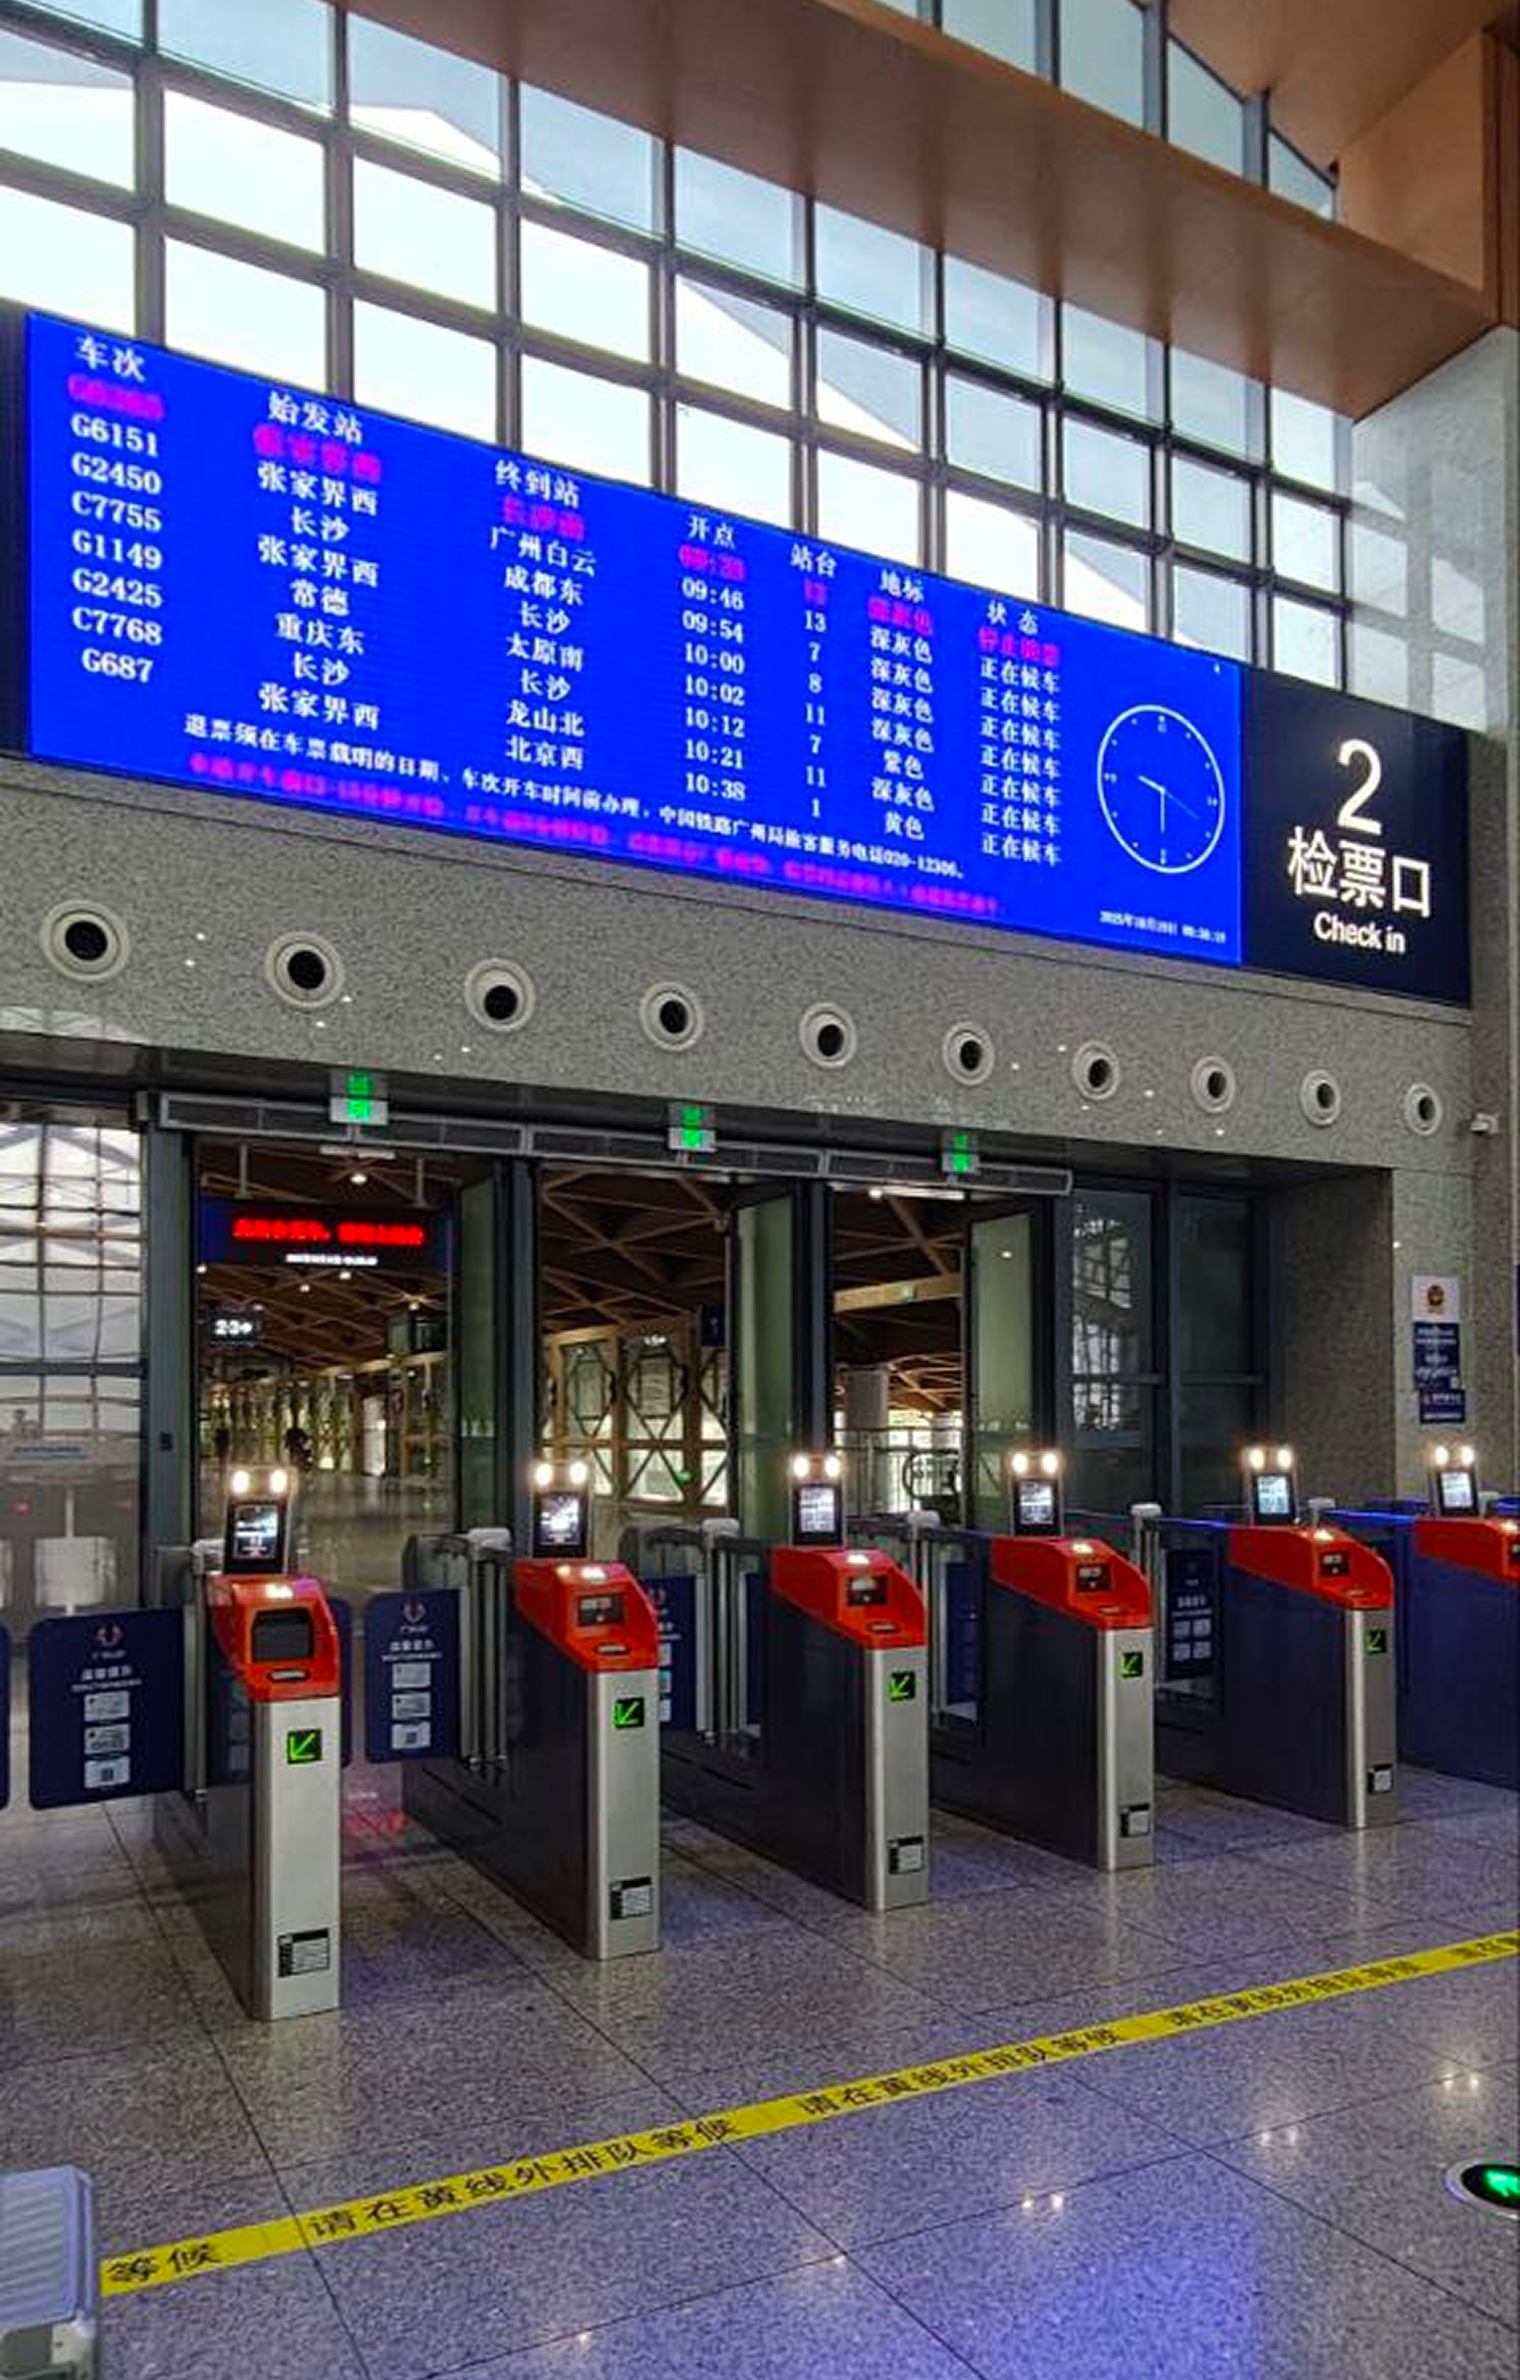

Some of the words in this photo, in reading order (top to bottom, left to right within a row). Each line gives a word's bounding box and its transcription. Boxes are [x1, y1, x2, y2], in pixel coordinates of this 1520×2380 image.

[71, 413, 158, 458] G6151
[257, 460, 378, 516] 张家界西
[489, 526, 597, 577] 广州白云
[681, 577, 744, 611] 09:46
[804, 609, 827, 633] 13
[870, 625, 933, 664] 深灰色
[980, 656, 1059, 695] 正在候车
[71, 452, 163, 495] G2450
[290, 506, 350, 542] 长沙
[503, 564, 583, 606] 成都东
[681, 610, 744, 644] 09:54
[809, 641, 821, 663] 7
[870, 655, 934, 694] 深灰色
[980, 686, 1059, 724] 正在候车
[76, 335, 145, 382] 车次
[267, 390, 364, 445] 始发站
[494, 458, 580, 509] 终到站
[688, 514, 735, 549] 开点
[790, 542, 837, 577] 站台
[986, 599, 1038, 635] 状态
[71, 491, 163, 532] C7755
[257, 534, 380, 588] 张家界西
[519, 601, 572, 635] 长沙
[684, 642, 745, 675] 10:00
[808, 672, 823, 694] 8
[870, 686, 934, 724] 深灰色
[980, 715, 1059, 753] 正在候车
[71, 529, 164, 571] G1149
[290, 578, 350, 617] 常德
[506, 631, 584, 673] 太原南
[684, 674, 746, 707] 10:02
[805, 702, 826, 726] 11
[871, 717, 934, 754] 深灰色
[980, 744, 1059, 782] 正在候车
[71, 567, 164, 609] G2425
[275, 612, 365, 656] 重庆东
[519, 668, 572, 702] 长沙
[685, 706, 746, 739] 10:12
[809, 733, 822, 755] 7
[981, 774, 1059, 810] 正在候车
[71, 606, 164, 647] C7768
[292, 651, 351, 686] 长沙
[505, 698, 586, 738] 龙山北
[685, 738, 744, 770] 10:21
[805, 765, 826, 788] 11
[871, 776, 935, 812] 深灰色
[981, 802, 1060, 837] 正在候车
[80, 646, 154, 684] G687
[257, 682, 381, 731] 张家界西
[504, 734, 584, 771] 北京西
[685, 771, 747, 801] 10:38
[811, 797, 821, 819] 1
[884, 811, 925, 842] 黄色
[981, 833, 1060, 867] 正在候车
[1287, 825, 1431, 919] 检票口
[1337, 738, 1382, 836] 2
[1313, 910, 1383, 948] Check
[1385, 924, 1407, 954] in
[107, 2241, 221, 2284] 等候
[307, 2116, 739, 2240] 请在黄线外排队等候
